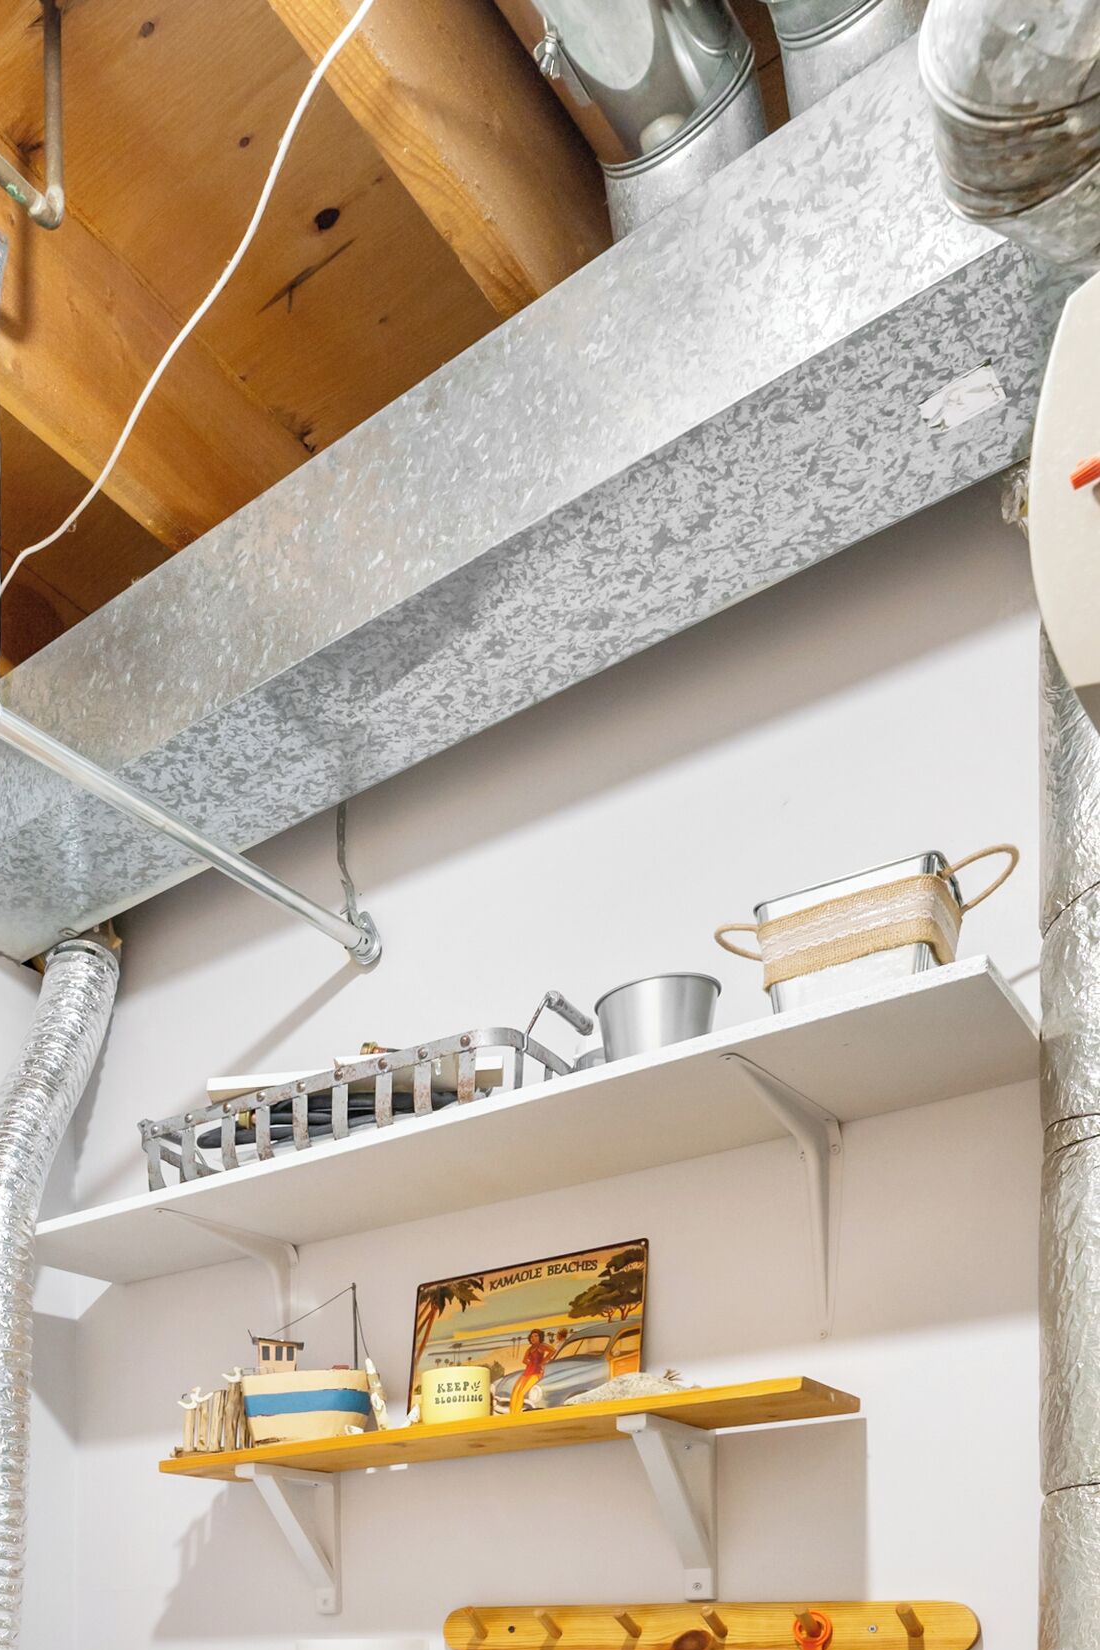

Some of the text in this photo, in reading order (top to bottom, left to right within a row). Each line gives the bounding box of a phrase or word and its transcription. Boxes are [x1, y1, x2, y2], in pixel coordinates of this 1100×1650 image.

[489, 1260, 598, 1291] KAMAOLE BEACHES
[437, 1381, 470, 1394] KEEP
[435, 1394, 483, 1405] BLOOMING
